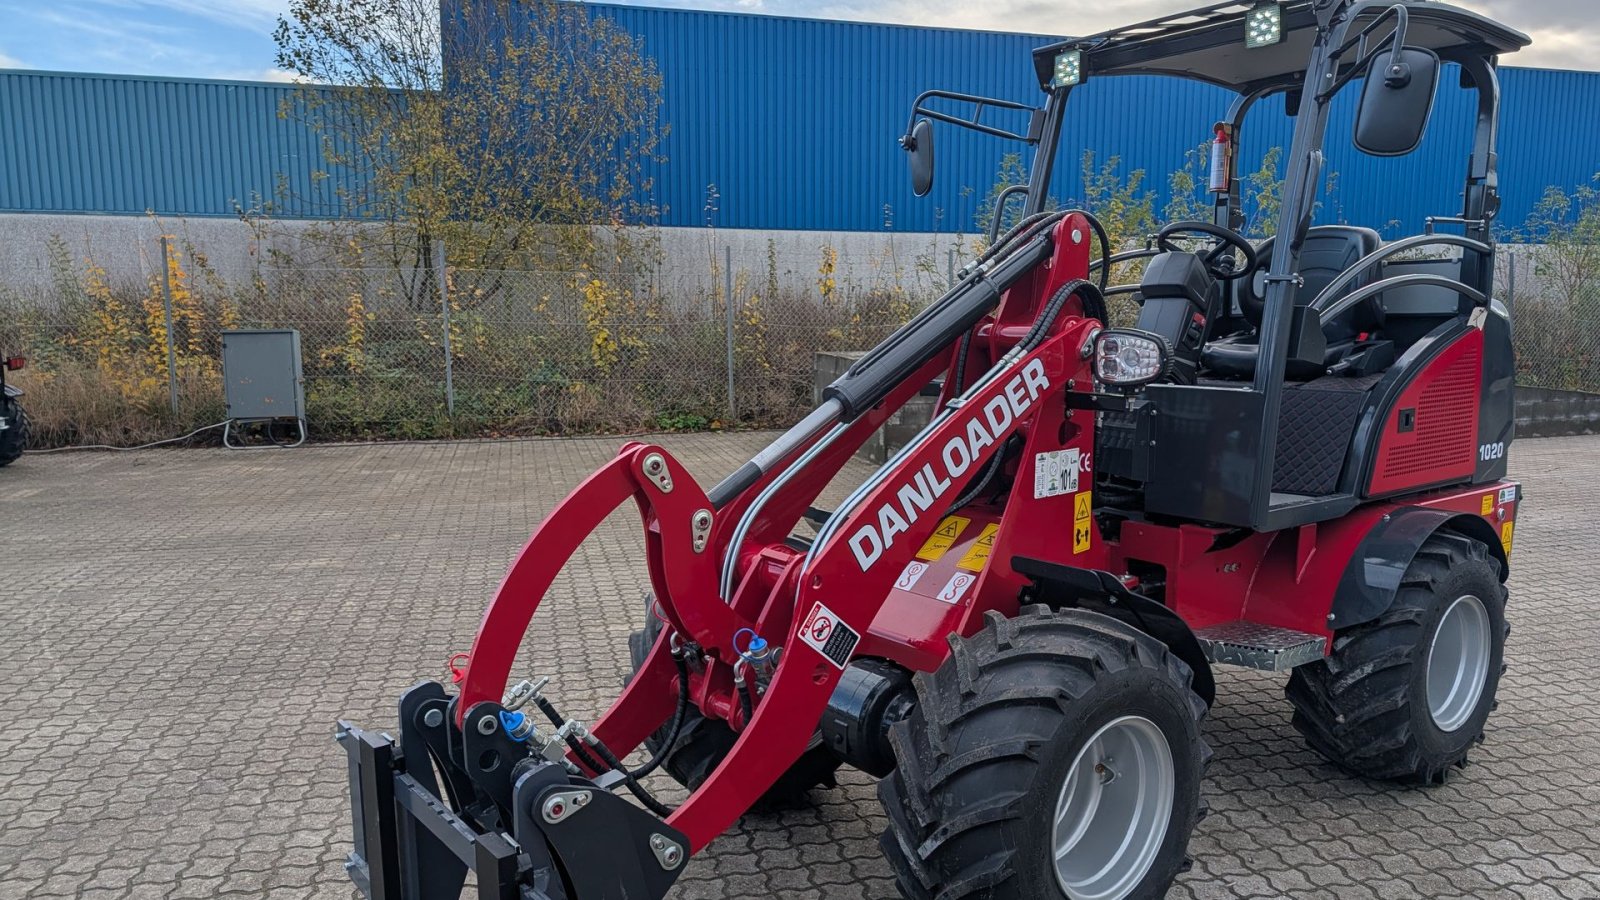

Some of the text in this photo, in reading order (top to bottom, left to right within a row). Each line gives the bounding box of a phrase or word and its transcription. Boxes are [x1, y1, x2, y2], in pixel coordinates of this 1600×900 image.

[1479, 442, 1504, 461] 1020
[848, 357, 1051, 574] DANLOADER
[1061, 468, 1071, 490] 101
[807, 607, 819, 626] DANGER
